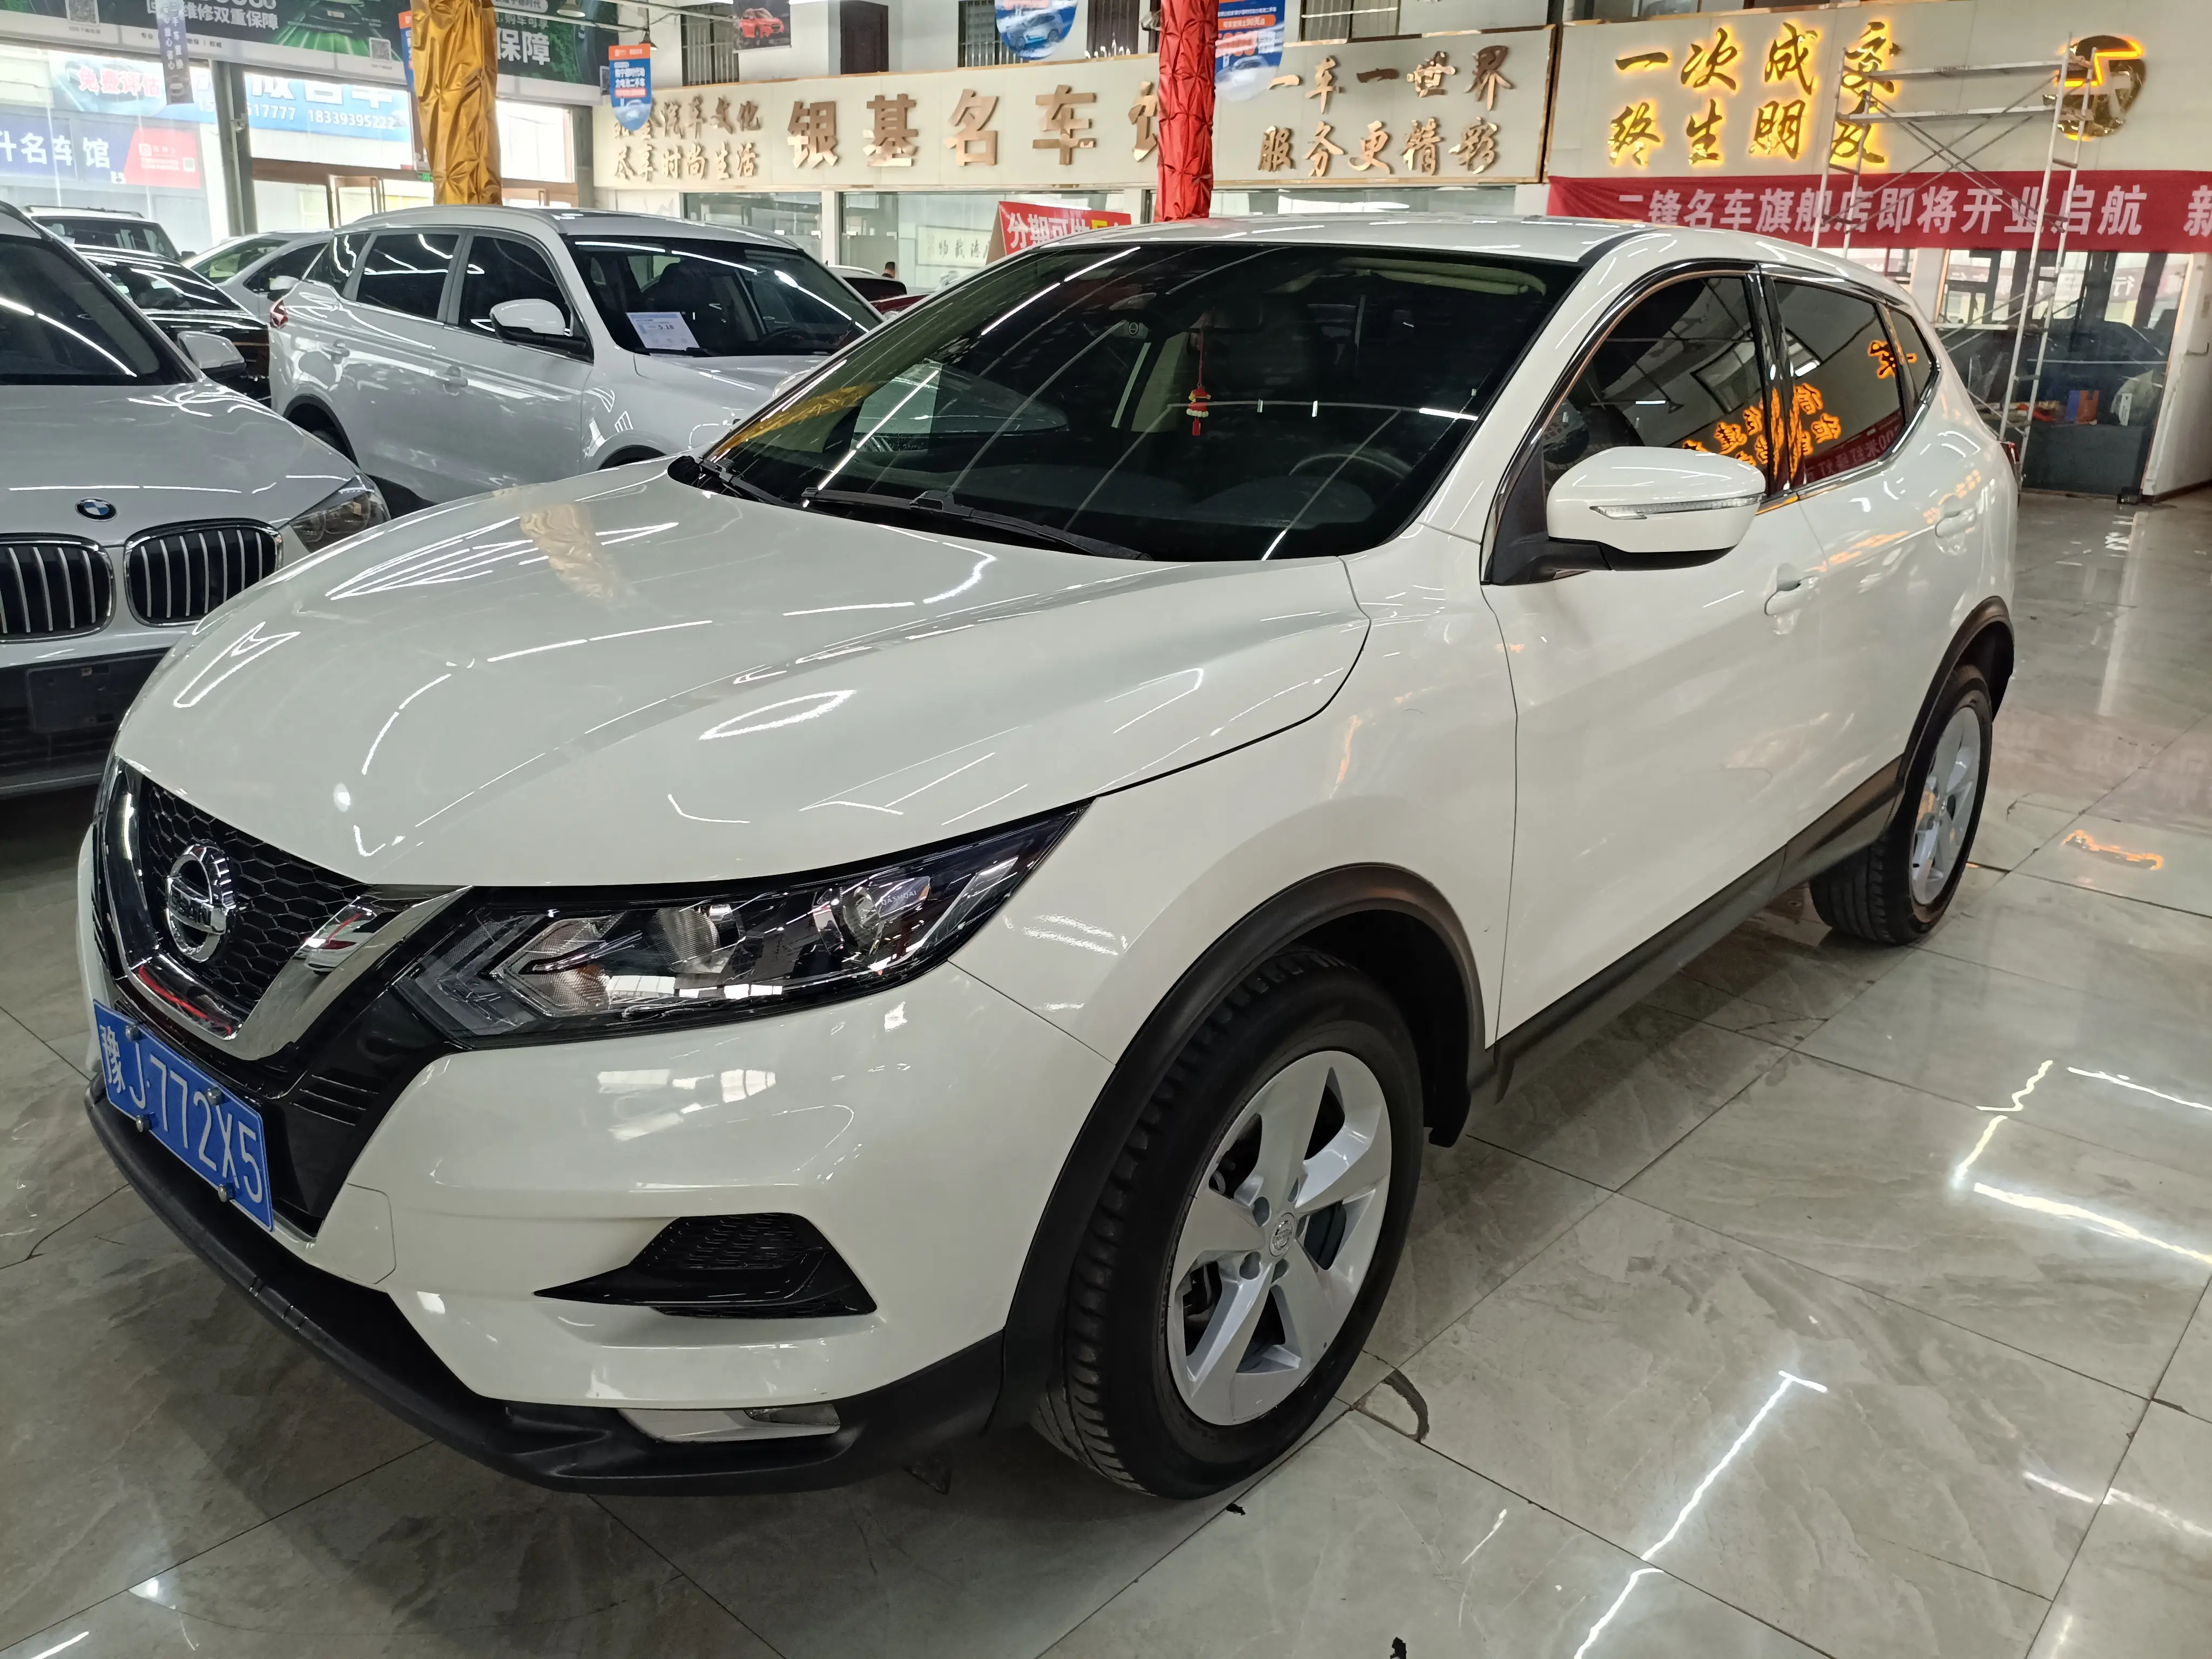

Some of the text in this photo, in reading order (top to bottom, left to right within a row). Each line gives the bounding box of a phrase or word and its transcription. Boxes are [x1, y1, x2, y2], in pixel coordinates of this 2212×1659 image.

[78, 67, 160, 98] 免费评估
[1269, 45, 1511, 113] 一车一世界
[1615, 21, 1900, 95] 一次成交
[308, 109, 394, 130] 18339395222
[1609, 90, 1885, 165] 终生朋友
[615, 141, 757, 182] 尽享时尚生活
[1258, 117, 1498, 177] 服务更精彩
[1007, 213, 1118, 248] 分期可
